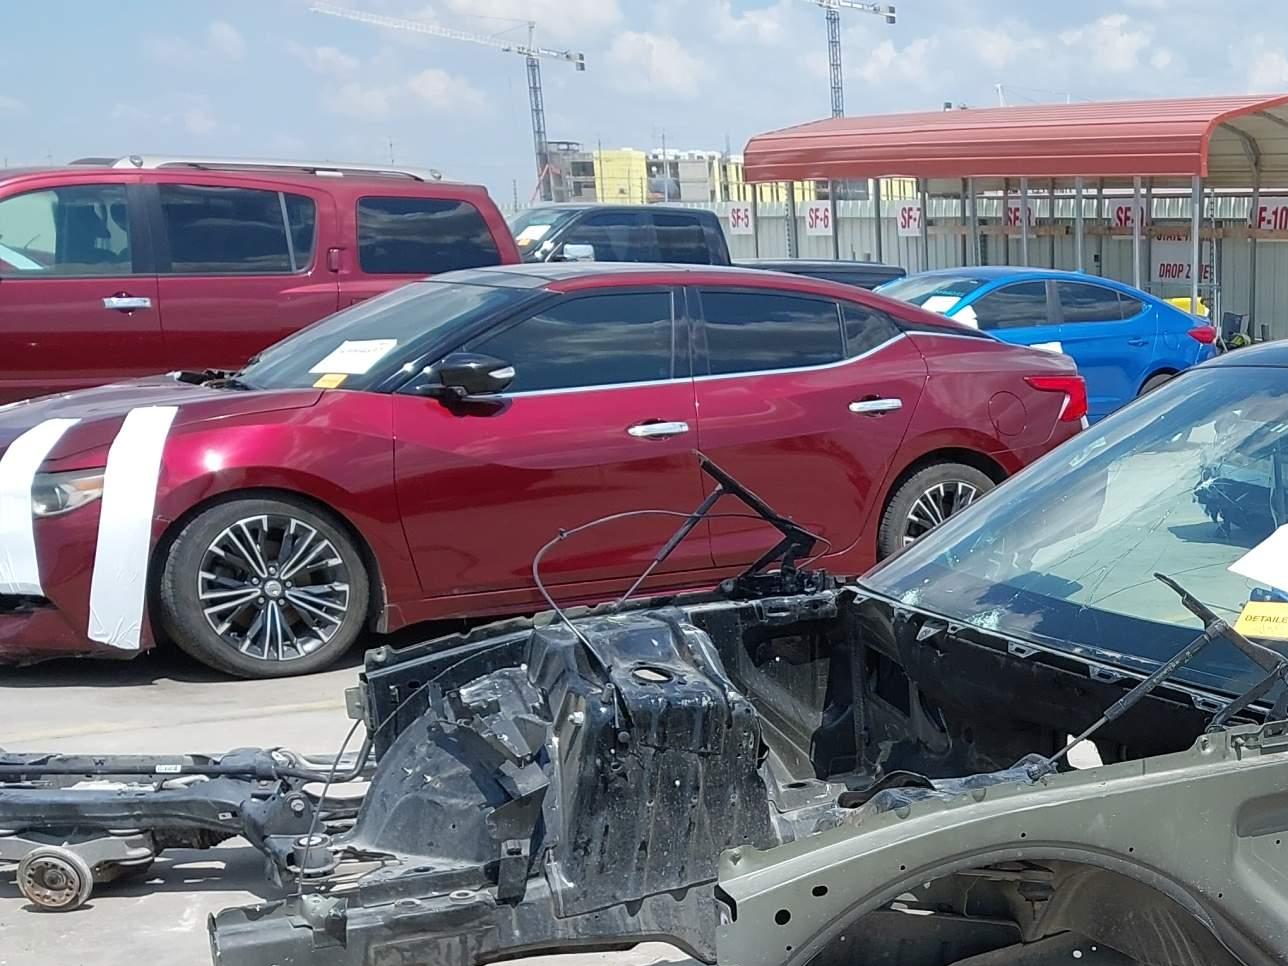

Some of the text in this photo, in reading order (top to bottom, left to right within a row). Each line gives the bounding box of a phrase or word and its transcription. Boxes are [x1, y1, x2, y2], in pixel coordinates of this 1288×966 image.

[731, 208, 749, 228] SF-5
[808, 207, 829, 228] SF-6
[901, 207, 921, 228] SF-7
[1249, 206, 1288, 229] F-10
[1159, 263, 1184, 278] DROP
